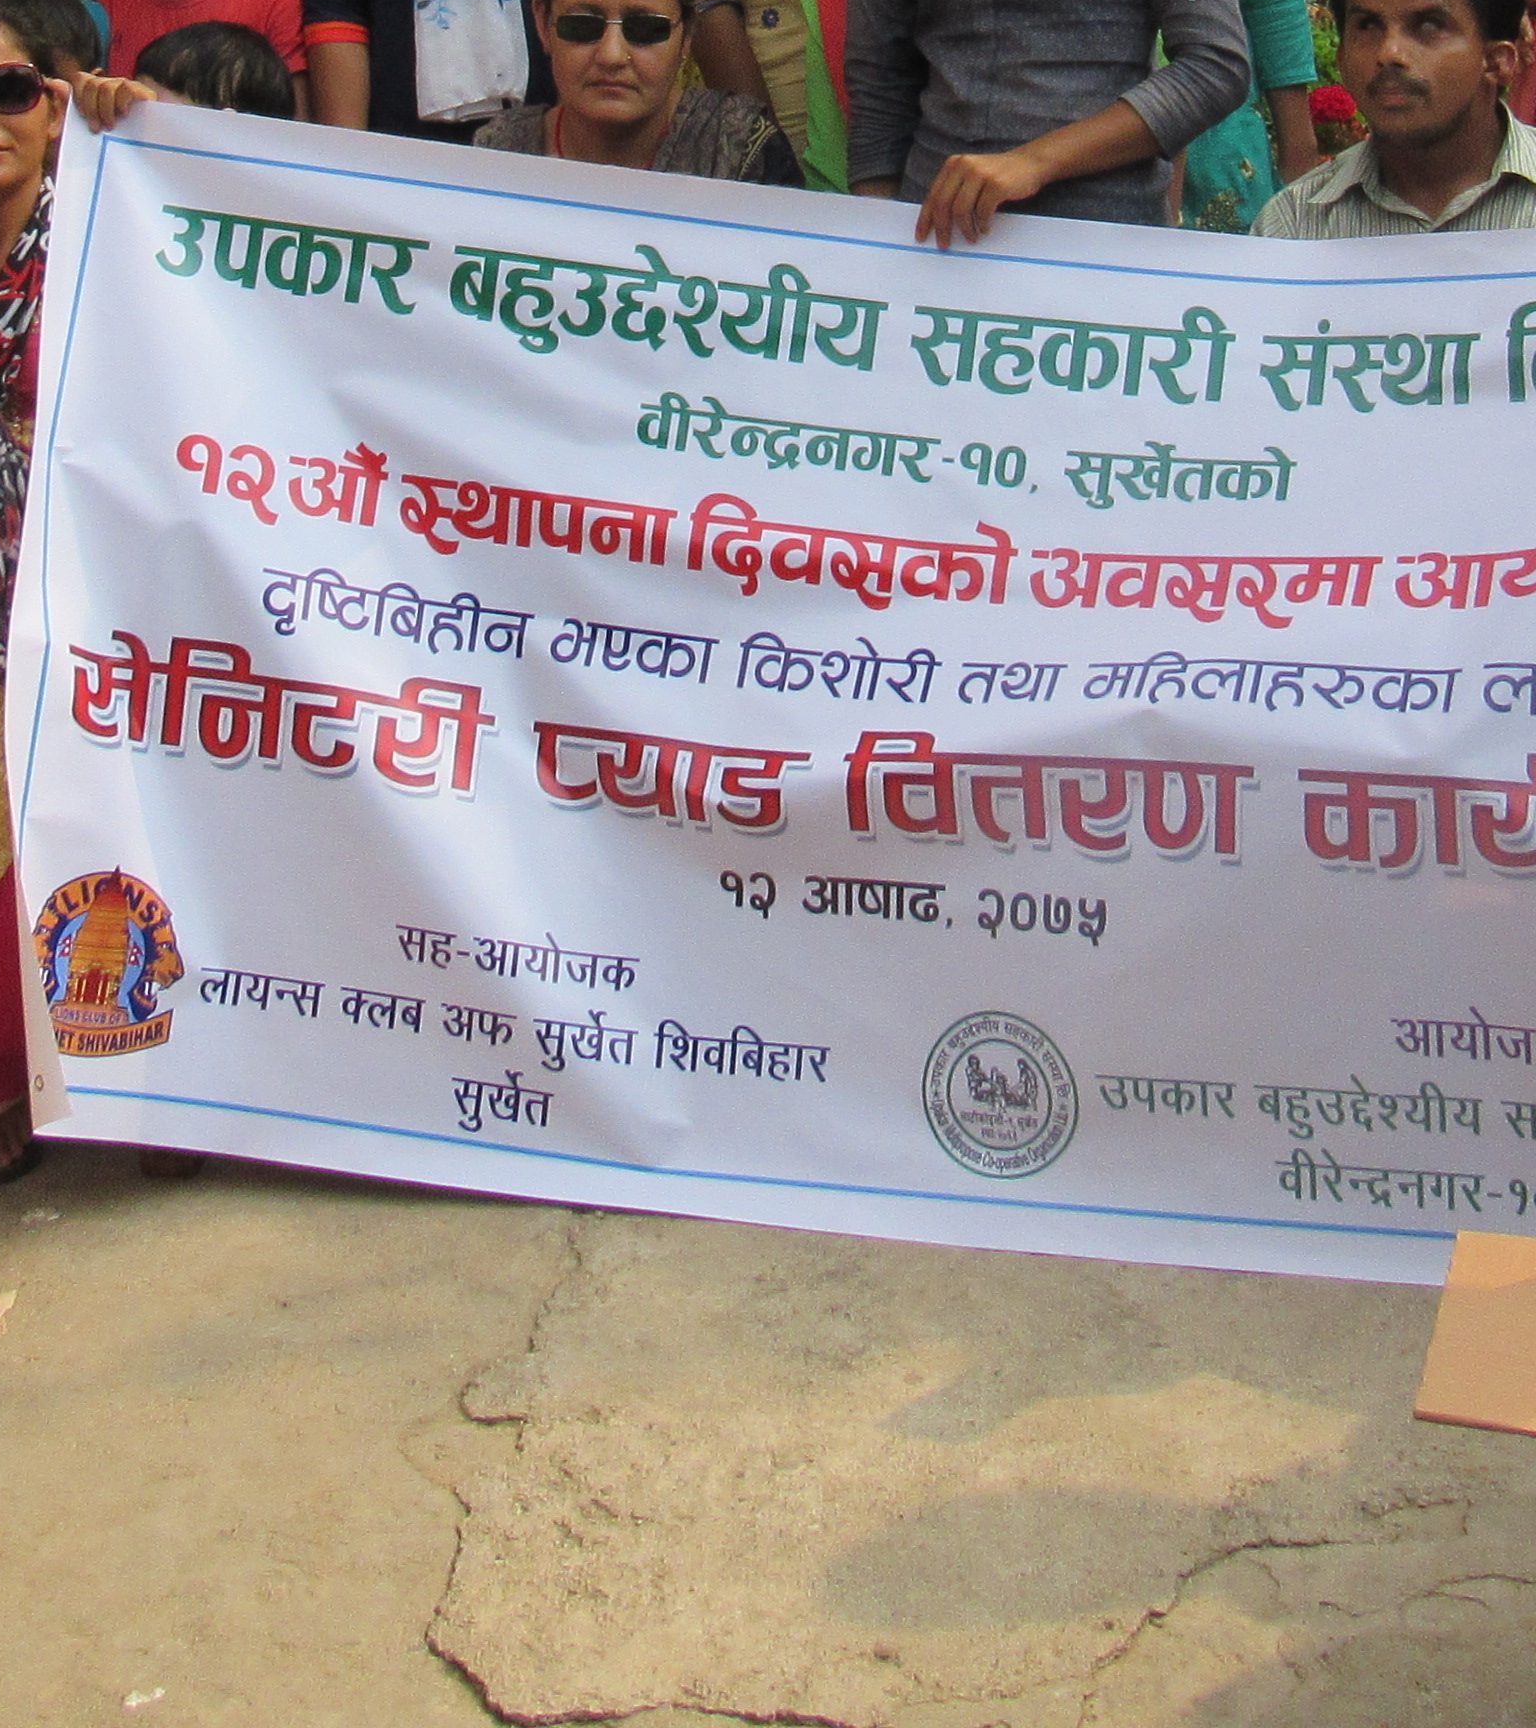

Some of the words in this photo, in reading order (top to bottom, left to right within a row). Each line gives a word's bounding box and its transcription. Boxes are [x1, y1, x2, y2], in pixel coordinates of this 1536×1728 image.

[156, 205, 430, 315] उपकार
[450, 245, 888, 372] बहुउद्देश्यीय
[911, 306, 1236, 405] सहकारी
[1260, 319, 1480, 413] संस्था
[637, 392, 1039, 494] वीरेन्द्रनगर-१०,
[1064, 441, 1297, 510] सुर्खेतको
[400, 474, 677, 566] स्थापना
[687, 493, 1018, 610] दिवसको
[1030, 548, 1383, 629] अवसरमा
[263, 568, 535, 659] दृष्टिबिहीन
[550, 618, 719, 684] भएका
[737, 632, 942, 703] किशोरी
[958, 662, 1067, 704] तथा
[1084, 651, 1462, 713] महिलाहरुका
[69, 630, 495, 797] सेनिटरी
[534, 721, 811, 833] प्याड
[846, 731, 1256, 857] वितरण
[396, 924, 639, 991] सह-आयोजक
[720, 870, 777, 919] १२
[977, 890, 1107, 947] २०७५
[77, 1020, 163, 1053] SHIVABIHAR
[199, 966, 324, 1018] लायन्स
[340, 986, 426, 1034] क्लब
[441, 1002, 516, 1048] अफ
[534, 1010, 635, 1073] सुर्खेत
[654, 1019, 831, 1083] शिवबिहार
[452, 1069, 555, 1133] सुर्खेत
[1096, 1074, 1235, 1119] उपकार
[1254, 1074, 1482, 1139] बहुउद्देश्यीय
